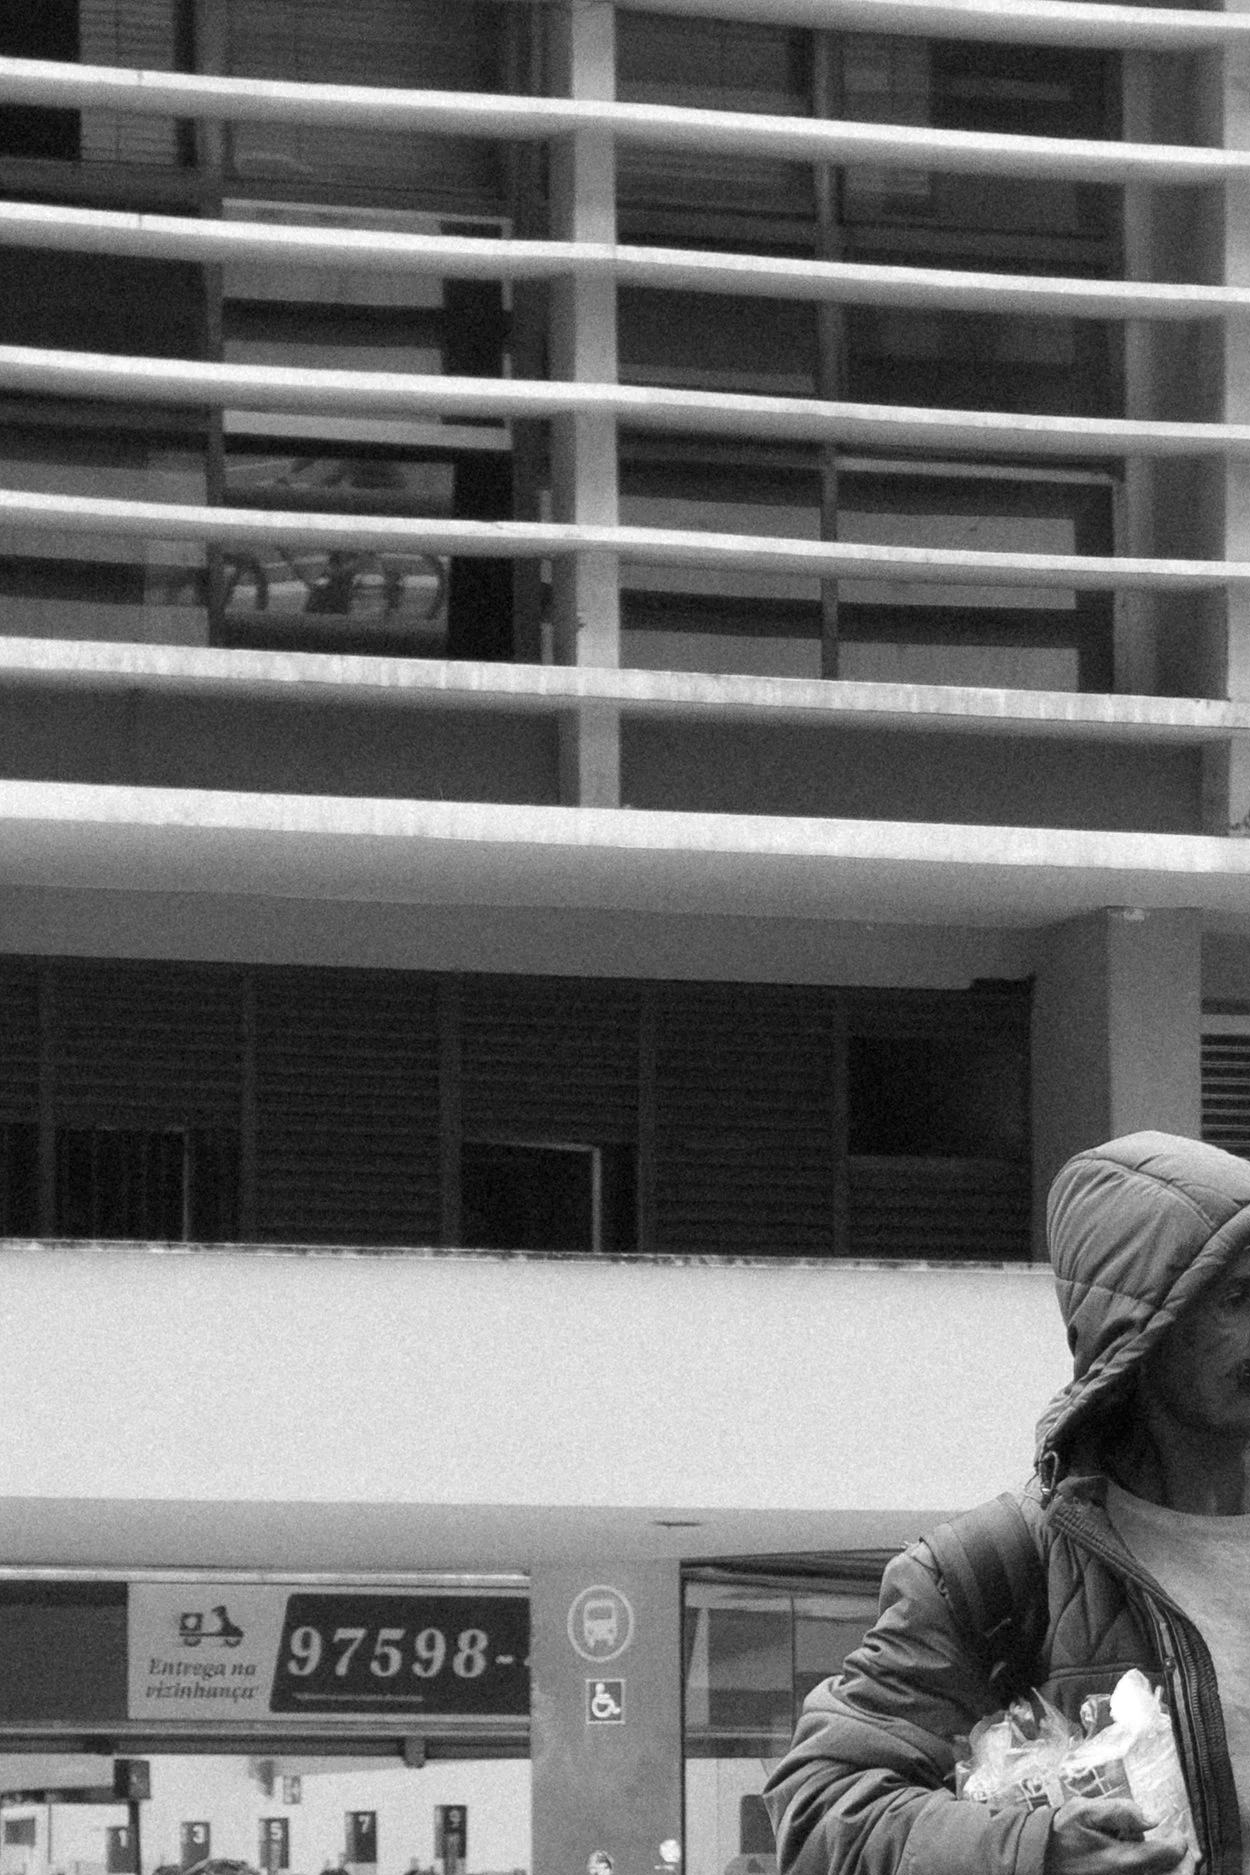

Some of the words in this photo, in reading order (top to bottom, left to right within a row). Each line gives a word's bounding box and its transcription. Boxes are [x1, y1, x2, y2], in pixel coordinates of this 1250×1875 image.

[149, 1658, 226, 1681] Entrega
[231, 1662, 258, 1677] na
[145, 1680, 258, 1704] vizinhança
[193, 1824, 206, 1844] 3
[270, 1821, 283, 1842] 5
[359, 1814, 372, 1835] 7
[118, 1828, 128, 1848] 1
